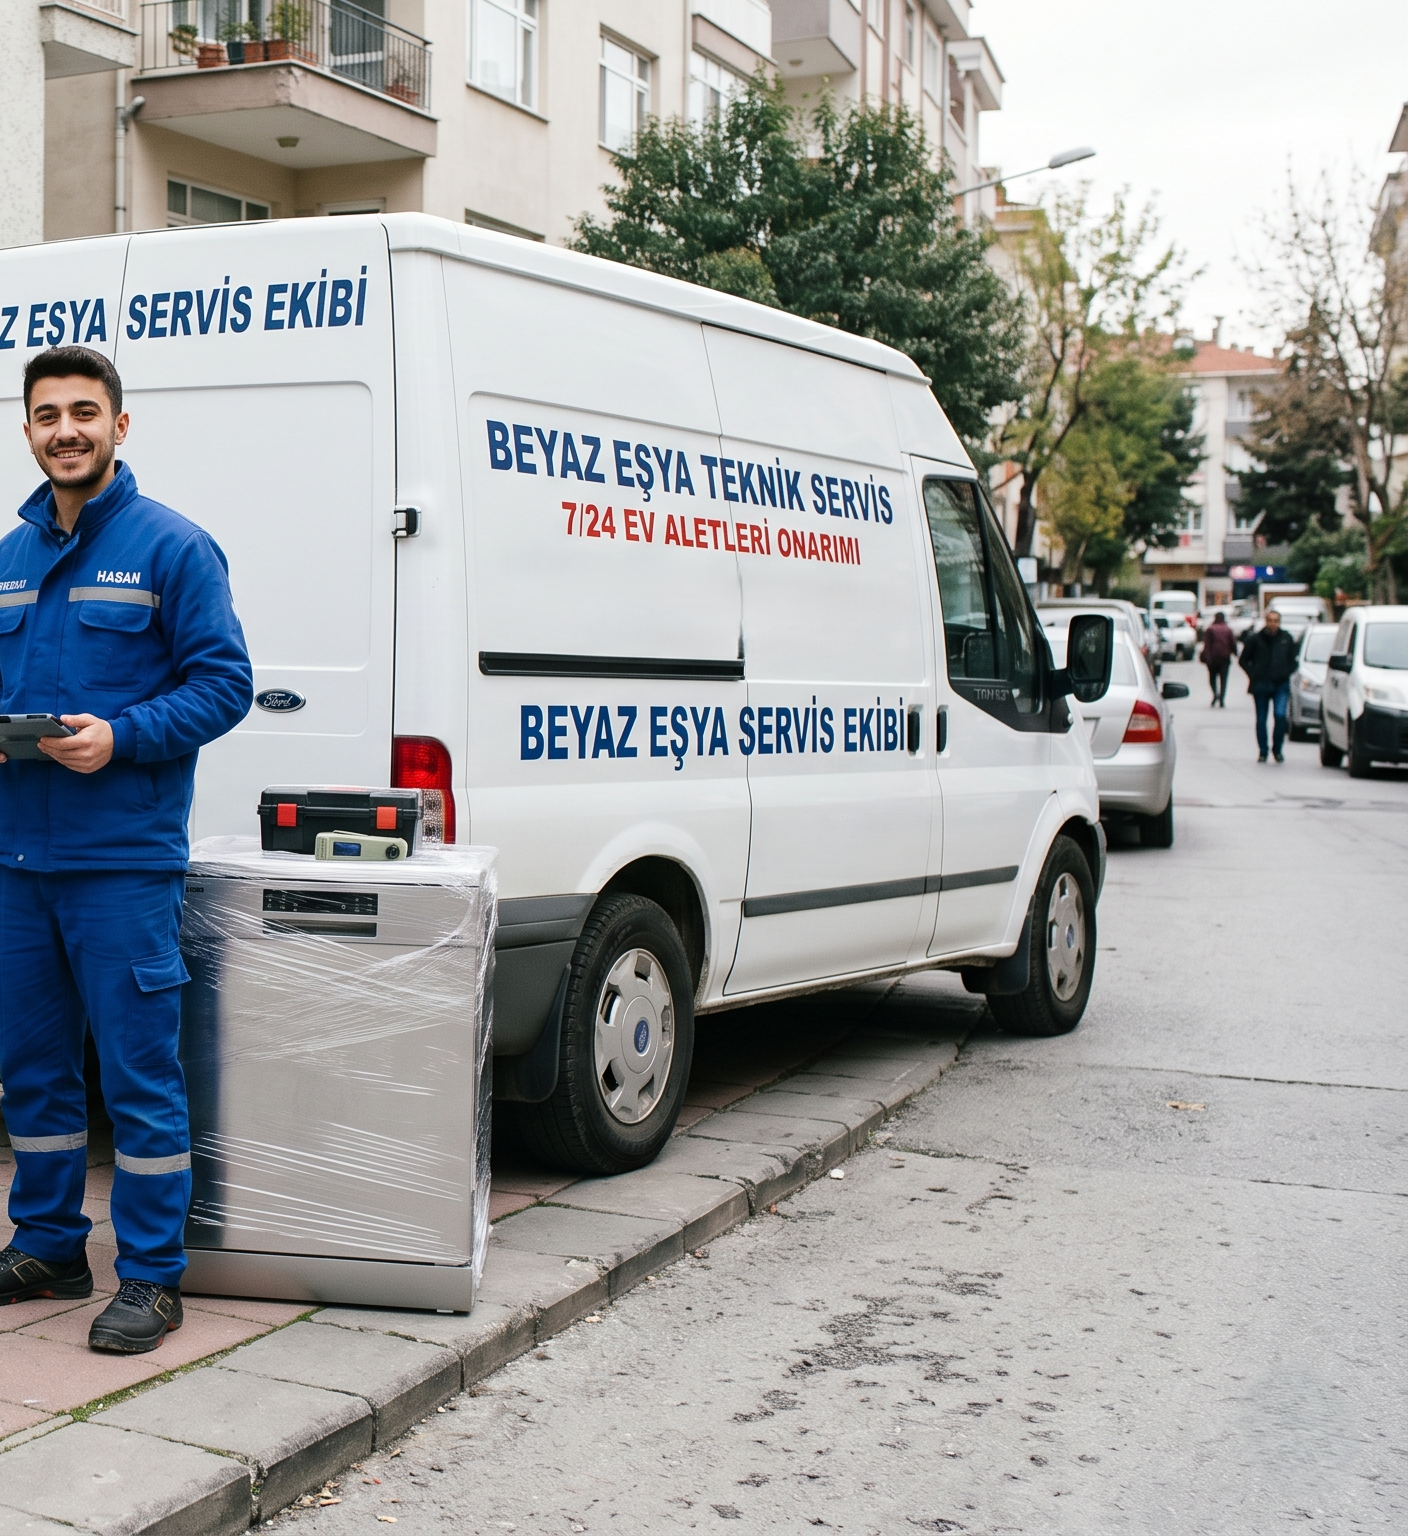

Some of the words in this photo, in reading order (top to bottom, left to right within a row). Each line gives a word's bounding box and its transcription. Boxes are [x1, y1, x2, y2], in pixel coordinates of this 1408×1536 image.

[126, 275, 253, 340] SERVİS
[265, 265, 368, 330] EKİBİ
[487, 419, 606, 483] BEYAZ
[614, 439, 695, 502] EŞYA
[701, 455, 806, 512] TEKNİK
[811, 472, 894, 525] SERVİS
[623, 508, 655, 543] EV
[664, 513, 772, 556] ALETLERİ
[777, 528, 861, 567] ONARIMI
[96, 570, 141, 585] HASAN
[520, 704, 638, 761] BEYAZ
[650, 705, 729, 771] EŞYA
[739, 694, 835, 756] SERVİS
[844, 696, 905, 753] EKİBİ
